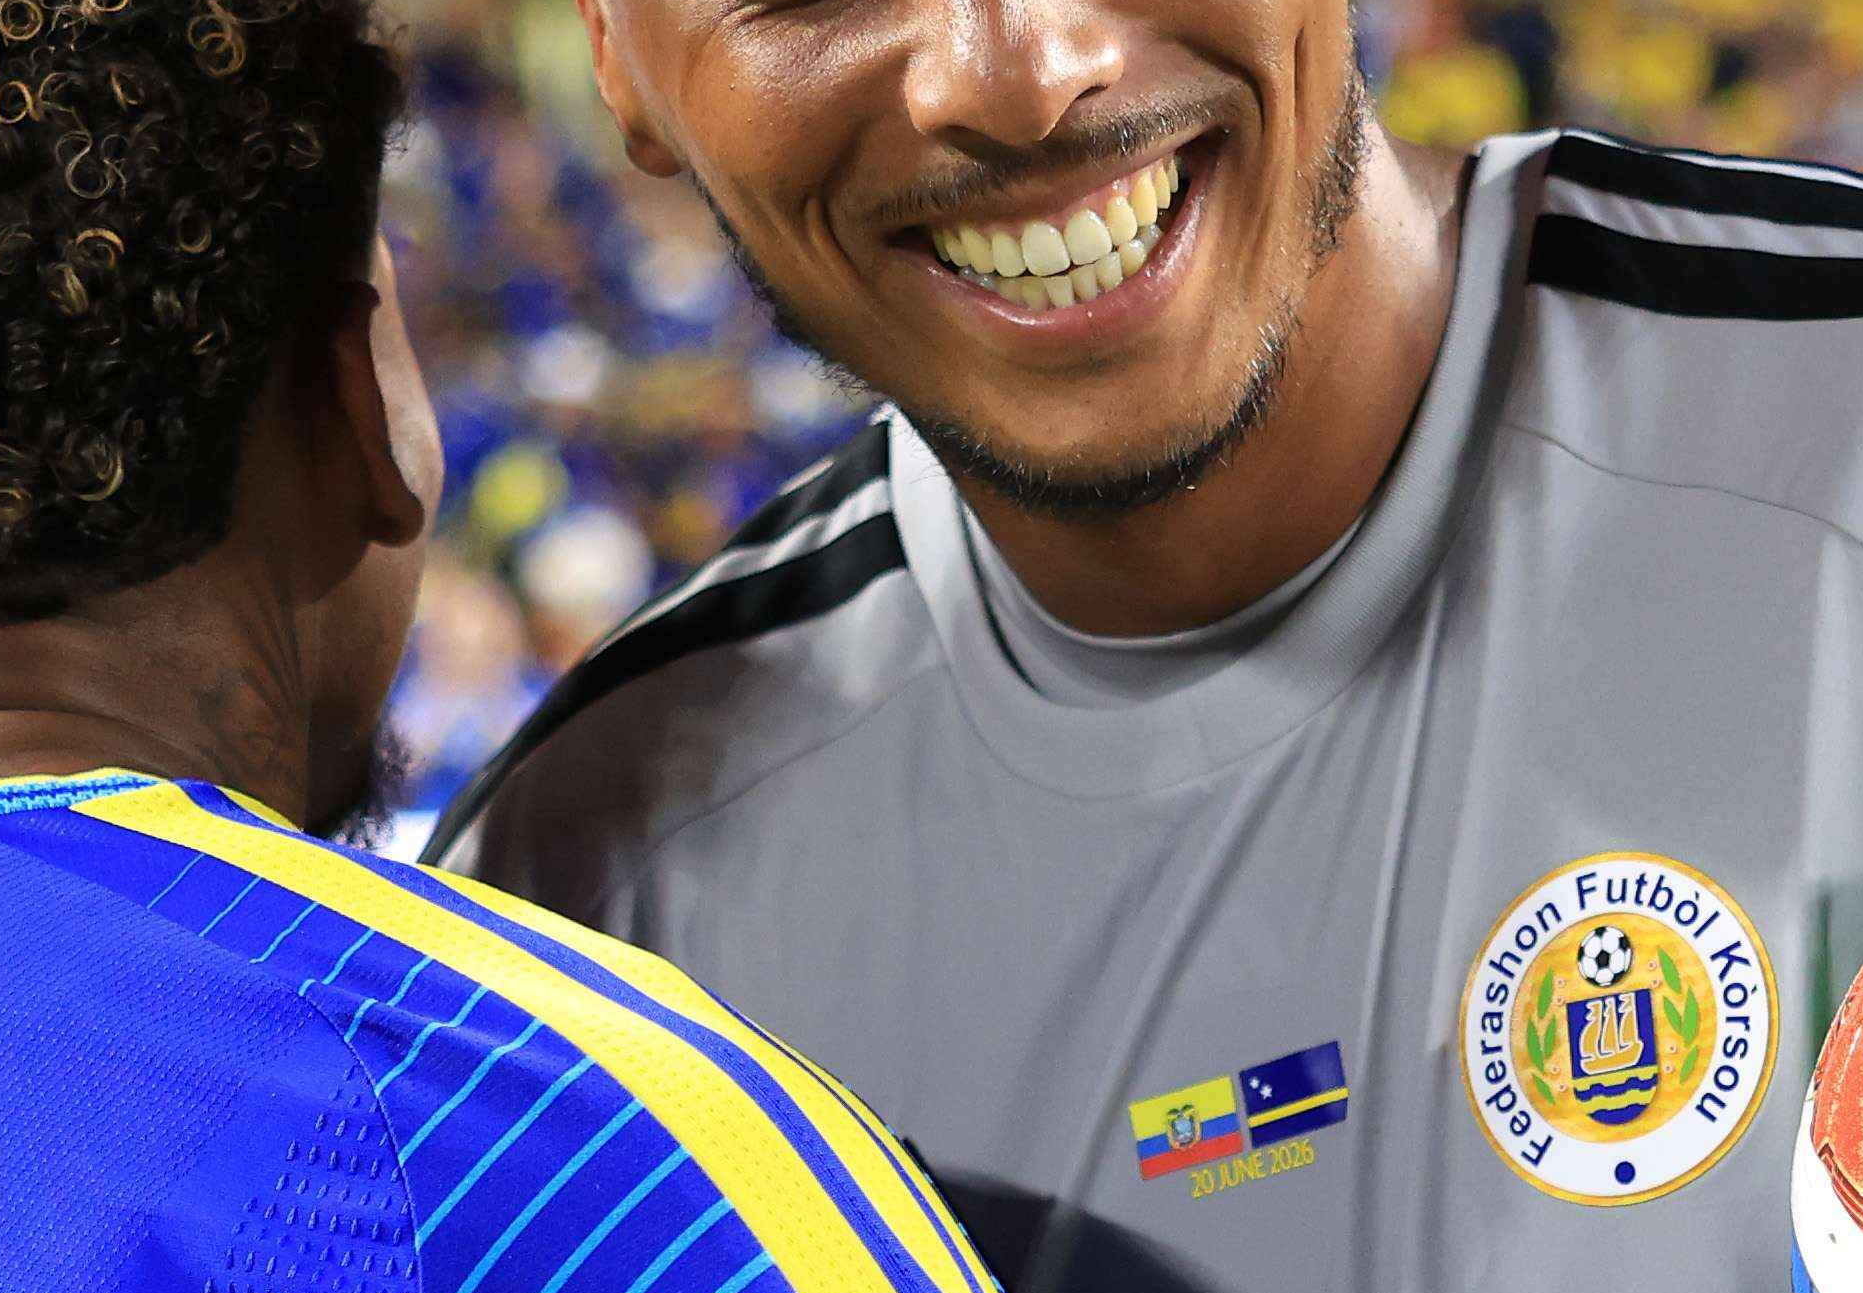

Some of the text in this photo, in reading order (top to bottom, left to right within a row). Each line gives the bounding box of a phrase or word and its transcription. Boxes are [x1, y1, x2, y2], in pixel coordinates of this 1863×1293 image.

[1480, 871, 1759, 1168] Federashon Futbòl Kòrsou
[1191, 1138, 1315, 1198] 20 JUNE 2026
